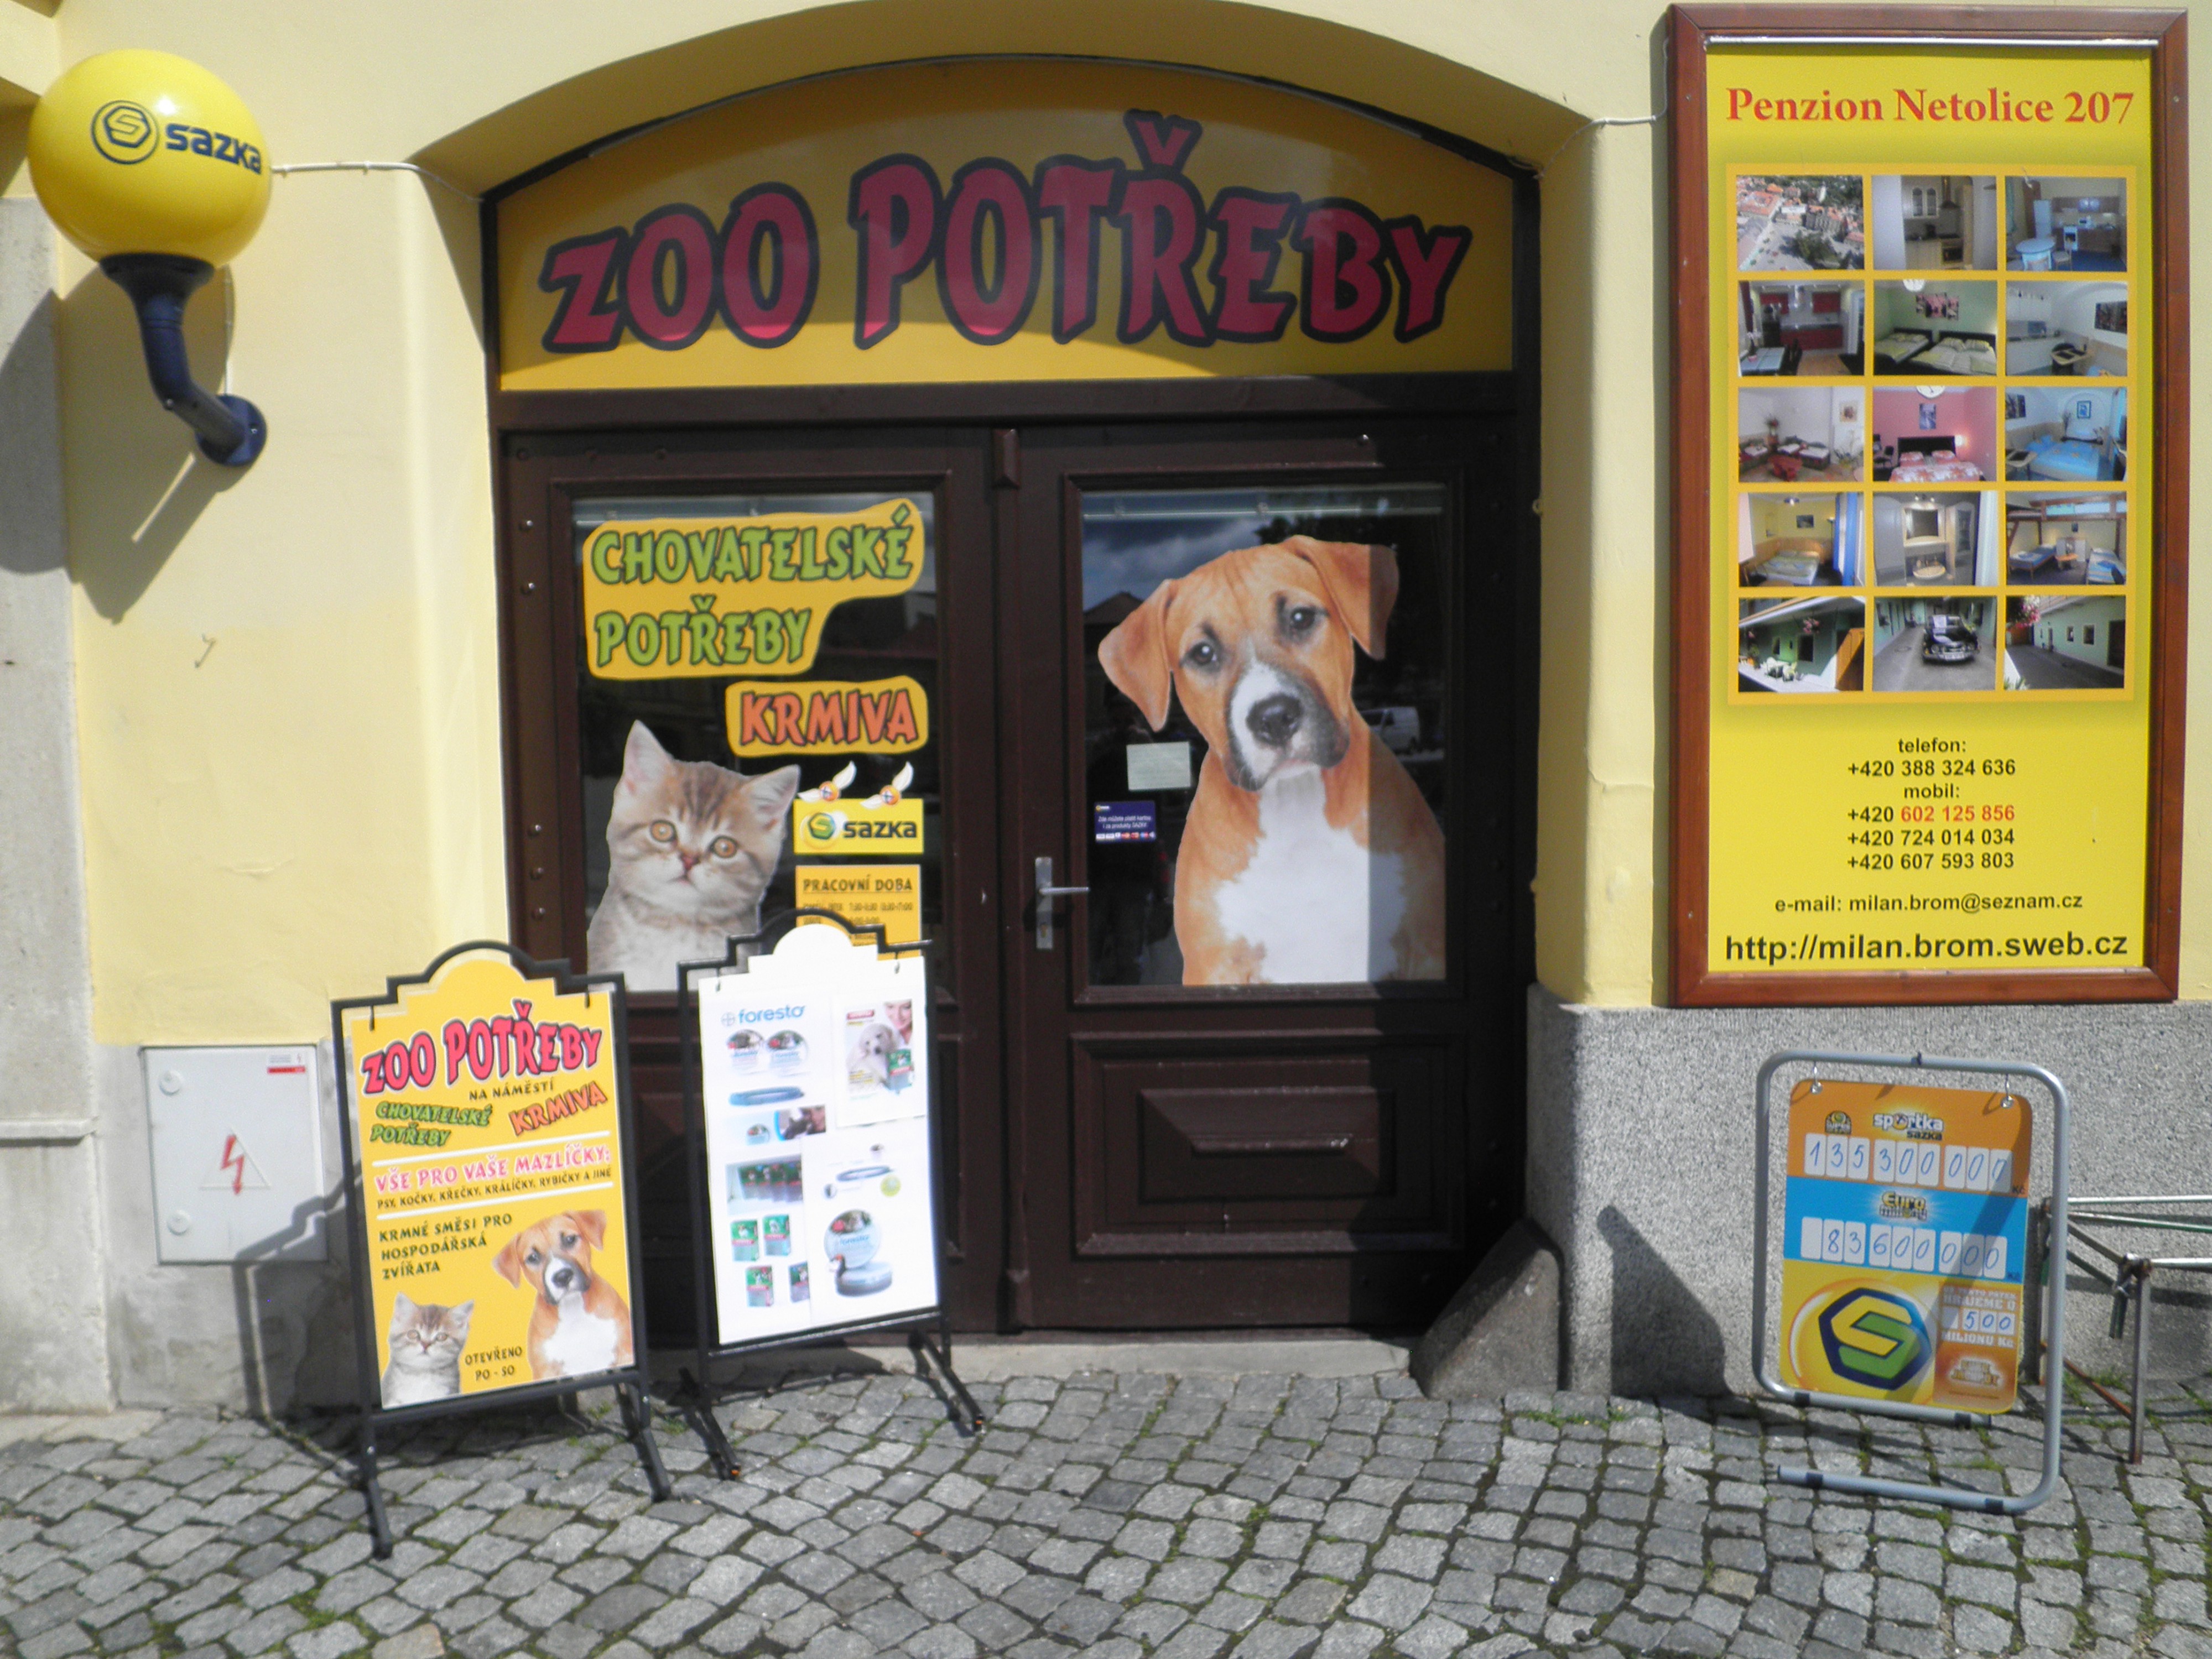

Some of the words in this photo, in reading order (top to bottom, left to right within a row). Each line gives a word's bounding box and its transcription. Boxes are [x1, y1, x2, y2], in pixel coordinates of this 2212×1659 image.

[1726, 87, 1884, 122] Penzion
[1893, 87, 2054, 123] Netolice
[2064, 91, 2135, 124] 207
[538, 181, 820, 353] ZOO
[847, 108, 1473, 352] POTŘEBY
[591, 503, 914, 585] CHOVATELSKÉ
[594, 594, 812, 666] POTŘEBY
[740, 689, 919, 747] KRMIVA
[1898, 738, 1966, 753] telefon:
[1847, 760, 1894, 777] +420
[1901, 759, 1935, 776] 388
[1942, 759, 1976, 776] 324
[1982, 759, 2016, 776] 636
[1904, 784, 1960, 800] mobil:
[1847, 806, 1894, 823] +420
[1901, 805, 1934, 822] 602
[1942, 805, 1975, 822] 125
[1981, 805, 2015, 821] 856
[1847, 830, 1894, 846] +420
[1901, 830, 1934, 846] 724
[1941, 830, 1975, 846] 014
[1981, 828, 2015, 845] 034
[1847, 853, 1894, 870] +420
[1900, 853, 1934, 870] 607
[1941, 853, 1975, 869] 593
[1981, 852, 2015, 868] 803
[804, 874, 870, 891] PRACOVNÍ
[876, 878, 912, 891] DOBA
[1775, 895, 1843, 912] e-mail:
[1849, 893, 2083, 914] milan.brom@seznam.cz
[1726, 931, 2128, 965] http://milan.brom.sweb.cz
[738, 1005, 805, 1023] foresto
[362, 1031, 436, 1094] ZOO
[443, 999, 602, 1084] POTŘEBY
[469, 1091, 487, 1100] NA
[492, 1077, 554, 1098] NÁMĚSTÍ
[375, 1101, 493, 1127] CHOVATELSKÉ
[508, 1081, 608, 1137] KRMIVA
[1873, 1112, 1944, 1131] sportka
[370, 1121, 451, 1147] POTŘEBY
[374, 1168, 412, 1194] VŠE
[418, 1166, 458, 1190] PRO
[463, 1154, 508, 1182] VAŠE
[514, 1143, 611, 1175] MAZLÍČKY:
[1809, 1141, 1865, 1167] 135
[1880, 1146, 1934, 1175] 300
[539, 1172, 580, 1187] RYBIČKY
[592, 1167, 612, 1178] JINÉ
[378, 1221, 429, 1243] KRMNÉ
[434, 1214, 477, 1235] SMĚSI
[483, 1213, 513, 1228] PRO
[381, 1232, 487, 1261] HOSPODÁŘSKÁ
[1828, 1229, 1862, 1260] 83
[1873, 1233, 1930, 1259] 600
[1942, 1243, 2000, 1269] 000
[382, 1255, 441, 1280] ZVÍŘATA
[1965, 1311, 2011, 1330] 500
[464, 1345, 523, 1365] OTEVŘENO
[475, 1370, 490, 1381] PO
[501, 1365, 515, 1377] SO
